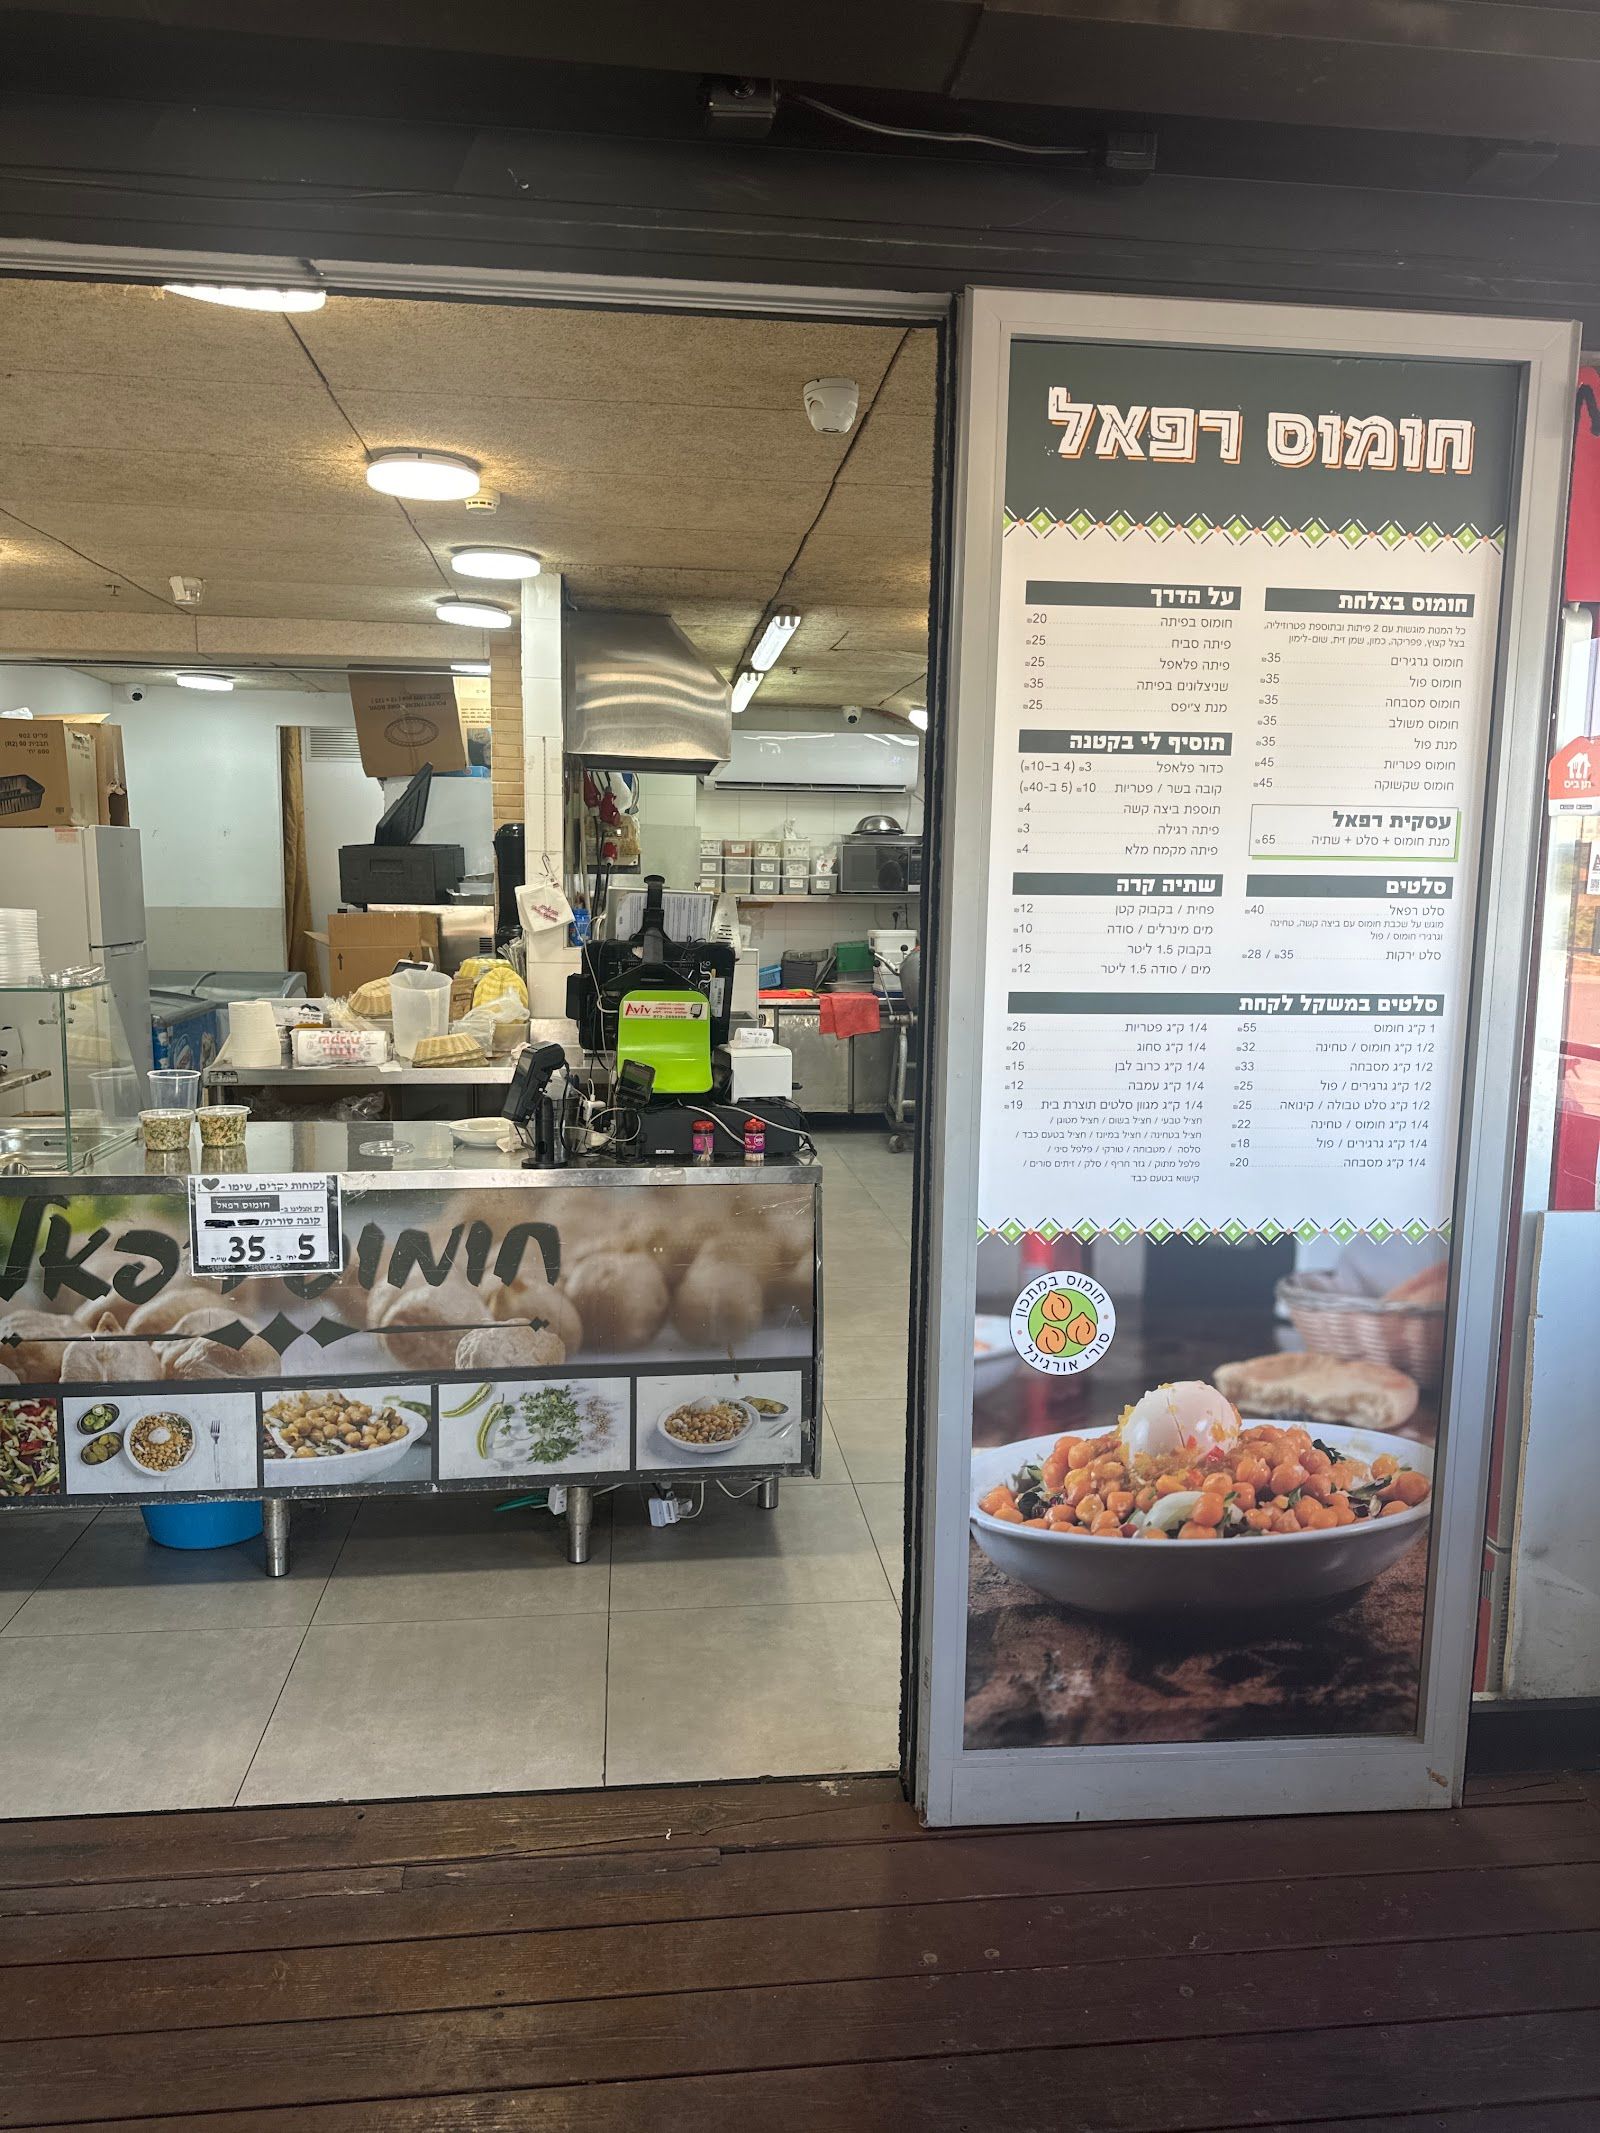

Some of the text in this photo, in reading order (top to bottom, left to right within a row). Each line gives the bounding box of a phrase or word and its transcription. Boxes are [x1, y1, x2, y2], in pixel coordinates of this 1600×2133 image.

[1045, 387, 1475, 474] חומוס רפאל
[1151, 587, 1234, 607] על הדרך
[1338, 593, 1468, 612] חומוס בצלחת
[1160, 617, 1233, 628] חומוס בפיתה
[1308, 623, 1345, 631] ובתוספת
[1347, 624, 1371, 632] פיתות
[1373, 624, 1379, 633] 2
[1381, 625, 1394, 633] עם
[1396, 626, 1426, 634] מוגשות
[1427, 627, 1453, 635] המנות
[1455, 625, 1466, 635] כל
[1171, 639, 1231, 650] פיתה סביח
[1348, 637, 1365, 646] שמן
[1448, 638, 1465, 648] בצל
[1159, 658, 1230, 671] פיתה פלאפל
[1390, 657, 1463, 668] חומוס גרגירים
[1137, 680, 1229, 692] שניצלונים בפיתה
[1409, 675, 1462, 688] חומוס פול
[1204, 703, 1228, 713] מנת
[1385, 698, 1460, 709] חומוס מסבחה
[1389, 716, 1459, 730] חומוס משולב
[1070, 732, 1225, 754] תוסיף לי בקטנה
[1414, 737, 1457, 750] מנת פול
[1156, 761, 1224, 774] כדור פלאפל
[1383, 760, 1456, 770] חומוס פטריות
[1114, 784, 1222, 796] קובה בשר פטריות
[1374, 780, 1454, 792] חומוס שקשוקה
[1564, 780, 1591, 790] תן ביס
[1123, 804, 1221, 816] תוספת ביצה קשה
[1332, 810, 1451, 832] עסקית רפאל
[1158, 823, 1220, 835] פיתה רגילה
[1311, 834, 1450, 847] מנת חומוס סלט שתיה
[1125, 843, 1218, 857] פיתה מקמח מלא
[1117, 879, 1216, 895] שתיה קרה
[1386, 877, 1446, 894] סלטים
[1115, 905, 1215, 916] פחית בקבוק קטן
[1389, 904, 1445, 916] סלט רפאל
[1107, 923, 1213, 935] מים מינרלים סודה
[1321, 920, 1340, 928] ביצה
[1343, 920, 1355, 928] עם
[1358, 920, 1381, 928] חומוס
[1383, 920, 1408, 928] שכבת
[1411, 919, 1422, 929] על
[1424, 921, 1444, 929] מוגש
[1370, 931, 1384, 940] פול
[1419, 933, 1443, 941] וגרגירי
[1127, 943, 1212, 957] בקבוק 1.5 ליטר
[1385, 949, 1442, 962] סלט ירקות
[1101, 963, 1211, 974] מים סודה 1.5 ליטר
[625, 1003, 651, 1016] Aviv
[1239, 995, 1438, 1014] סלטים במשקל לקחת
[1125, 1023, 1163, 1032] פטריות
[1189, 1023, 1207, 1032] 1/4
[1374, 1024, 1404, 1033] חומוס
[1430, 1024, 1435, 1033] 1
[1137, 1043, 1162, 1052] סחוג
[1188, 1042, 1206, 1052] 1/4
[1316, 1043, 1347, 1052] טחינה
[1360, 1043, 1391, 1052] חומוס
[1417, 1042, 1435, 1053] 1/2
[1115, 1060, 1132, 1073] לבן
[1136, 1062, 1161, 1071] כרוב
[1187, 1062, 1205, 1071] 1/4
[291, 1182, 325, 1191] לקוחות
[216, 1201, 239, 1209] רפאל
[228, 1235, 265, 1263] 35
[298, 1233, 315, 1260] 5
[1016, 1275, 1110, 1371] חומוס במתכון סורי אורגינל
